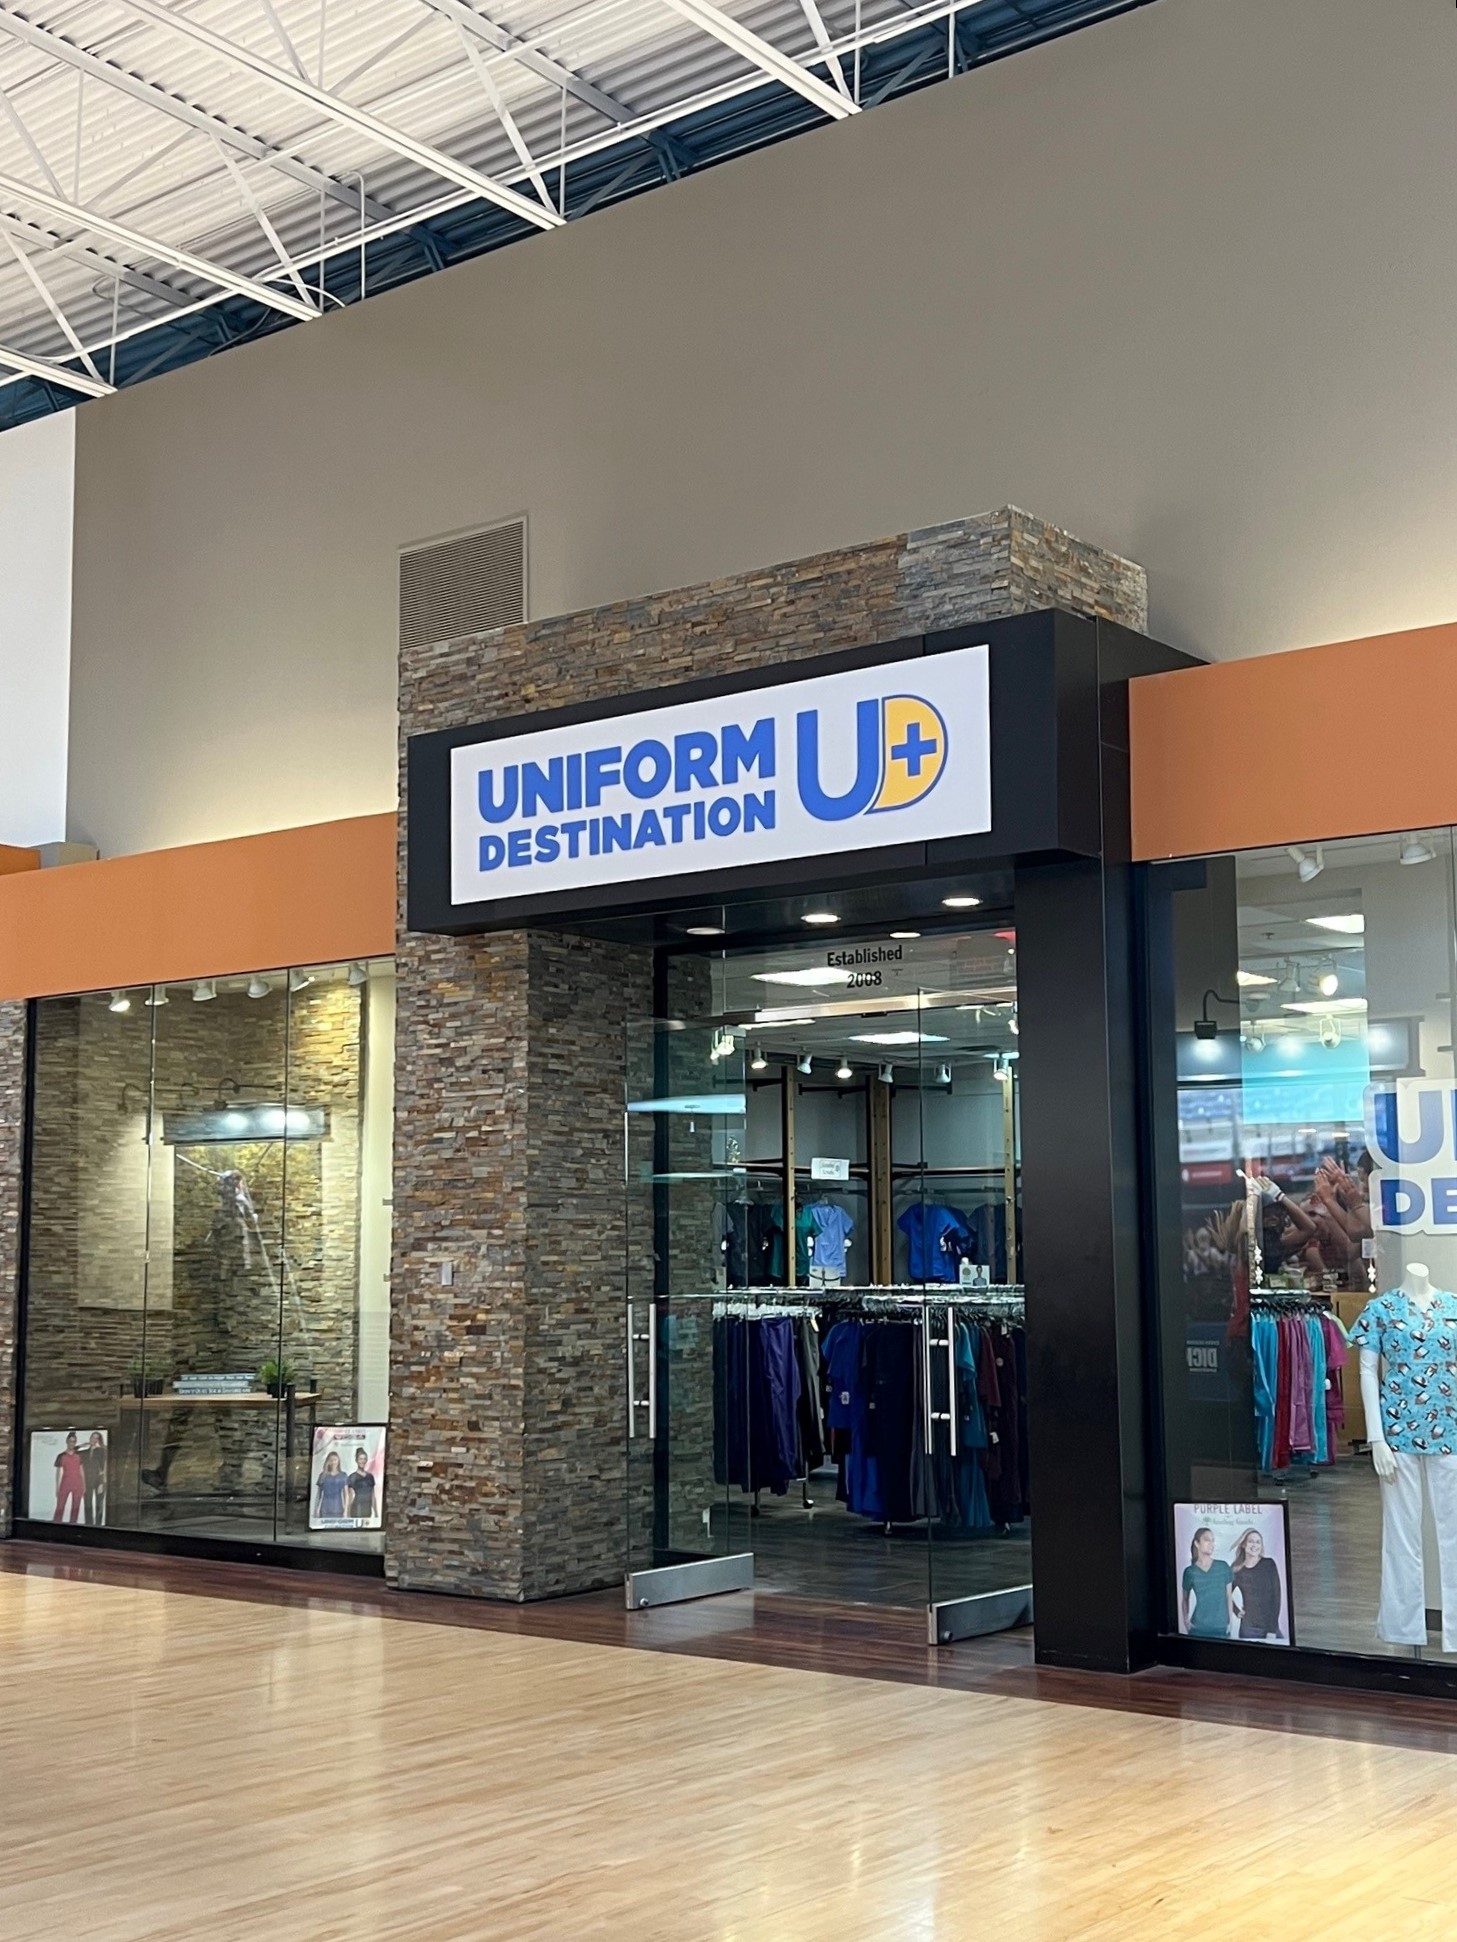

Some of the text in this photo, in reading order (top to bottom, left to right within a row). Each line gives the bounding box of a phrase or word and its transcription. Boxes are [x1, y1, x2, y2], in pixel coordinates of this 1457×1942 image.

[478, 717, 775, 824] UNIFORM
[479, 790, 776, 872] DESTINATION
[827, 945, 903, 967] Established
[847, 971, 882, 988] 2008
[1374, 1088, 1457, 1164] U
[1194, 1504, 1263, 1515] PURPLE LABEL
